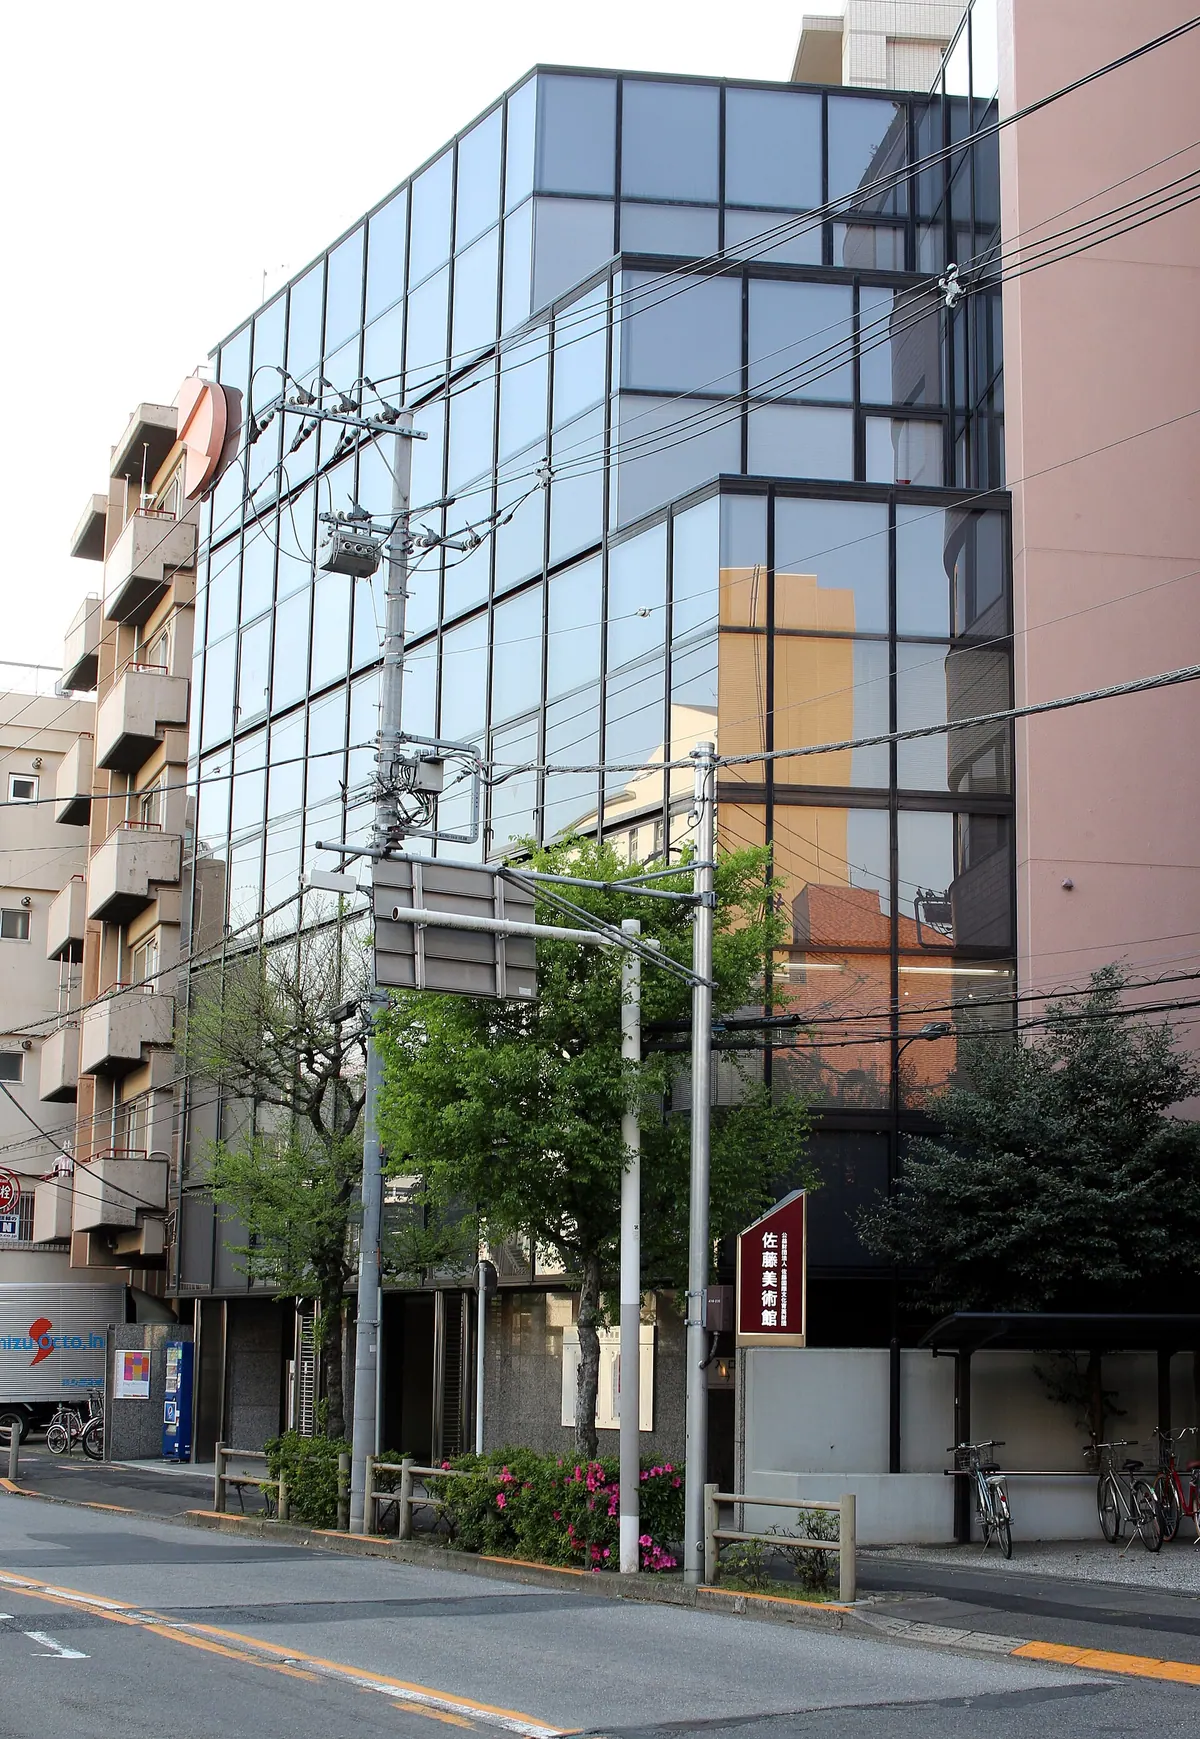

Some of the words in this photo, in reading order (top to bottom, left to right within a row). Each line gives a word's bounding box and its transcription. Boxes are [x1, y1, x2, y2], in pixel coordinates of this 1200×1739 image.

[761, 1231, 779, 1327] 佐藤美術館
